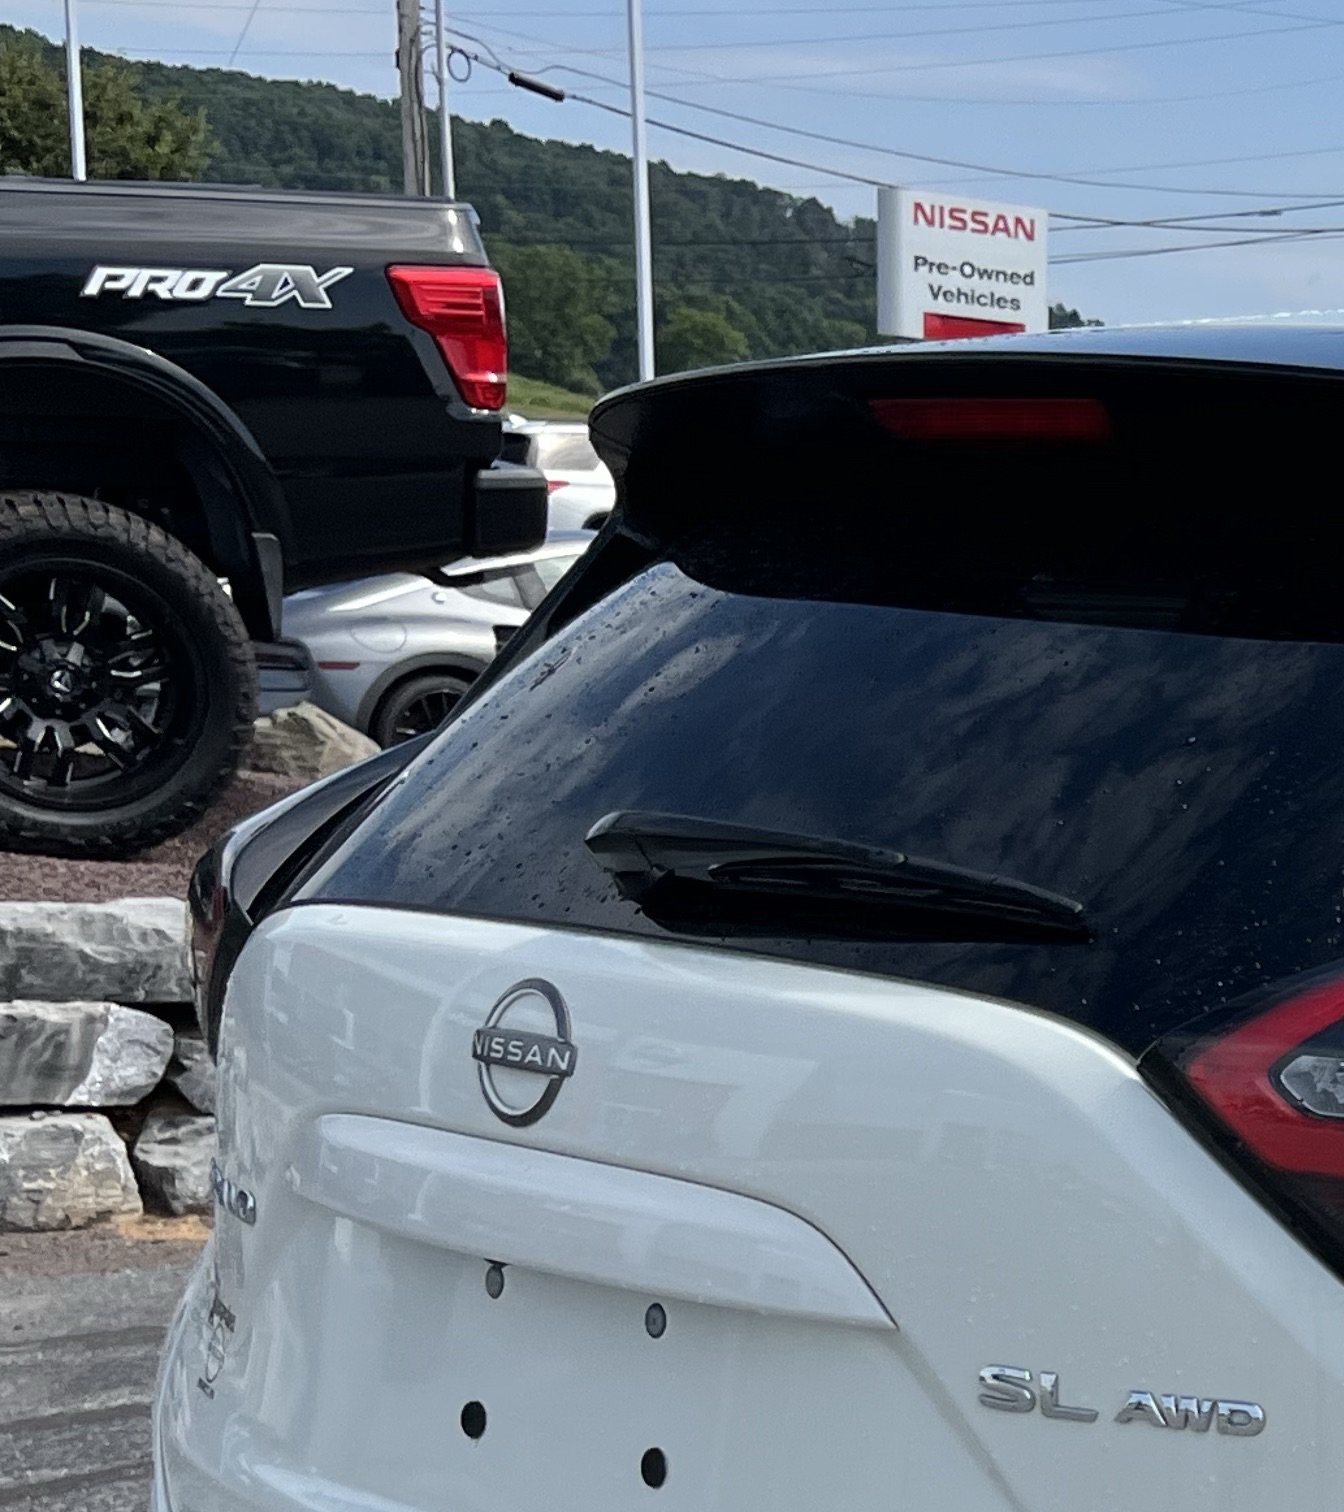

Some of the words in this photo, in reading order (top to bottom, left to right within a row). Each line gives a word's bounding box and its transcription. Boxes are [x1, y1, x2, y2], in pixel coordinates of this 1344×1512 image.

[913, 201, 1036, 241] NISSAN
[913, 255, 1036, 286] Pre-Owned
[928, 282, 1022, 311] Vehicles
[472, 1034, 571, 1071] NISSAN
[978, 1364, 1100, 1423] SL
[1114, 1390, 1267, 1437] AWD
